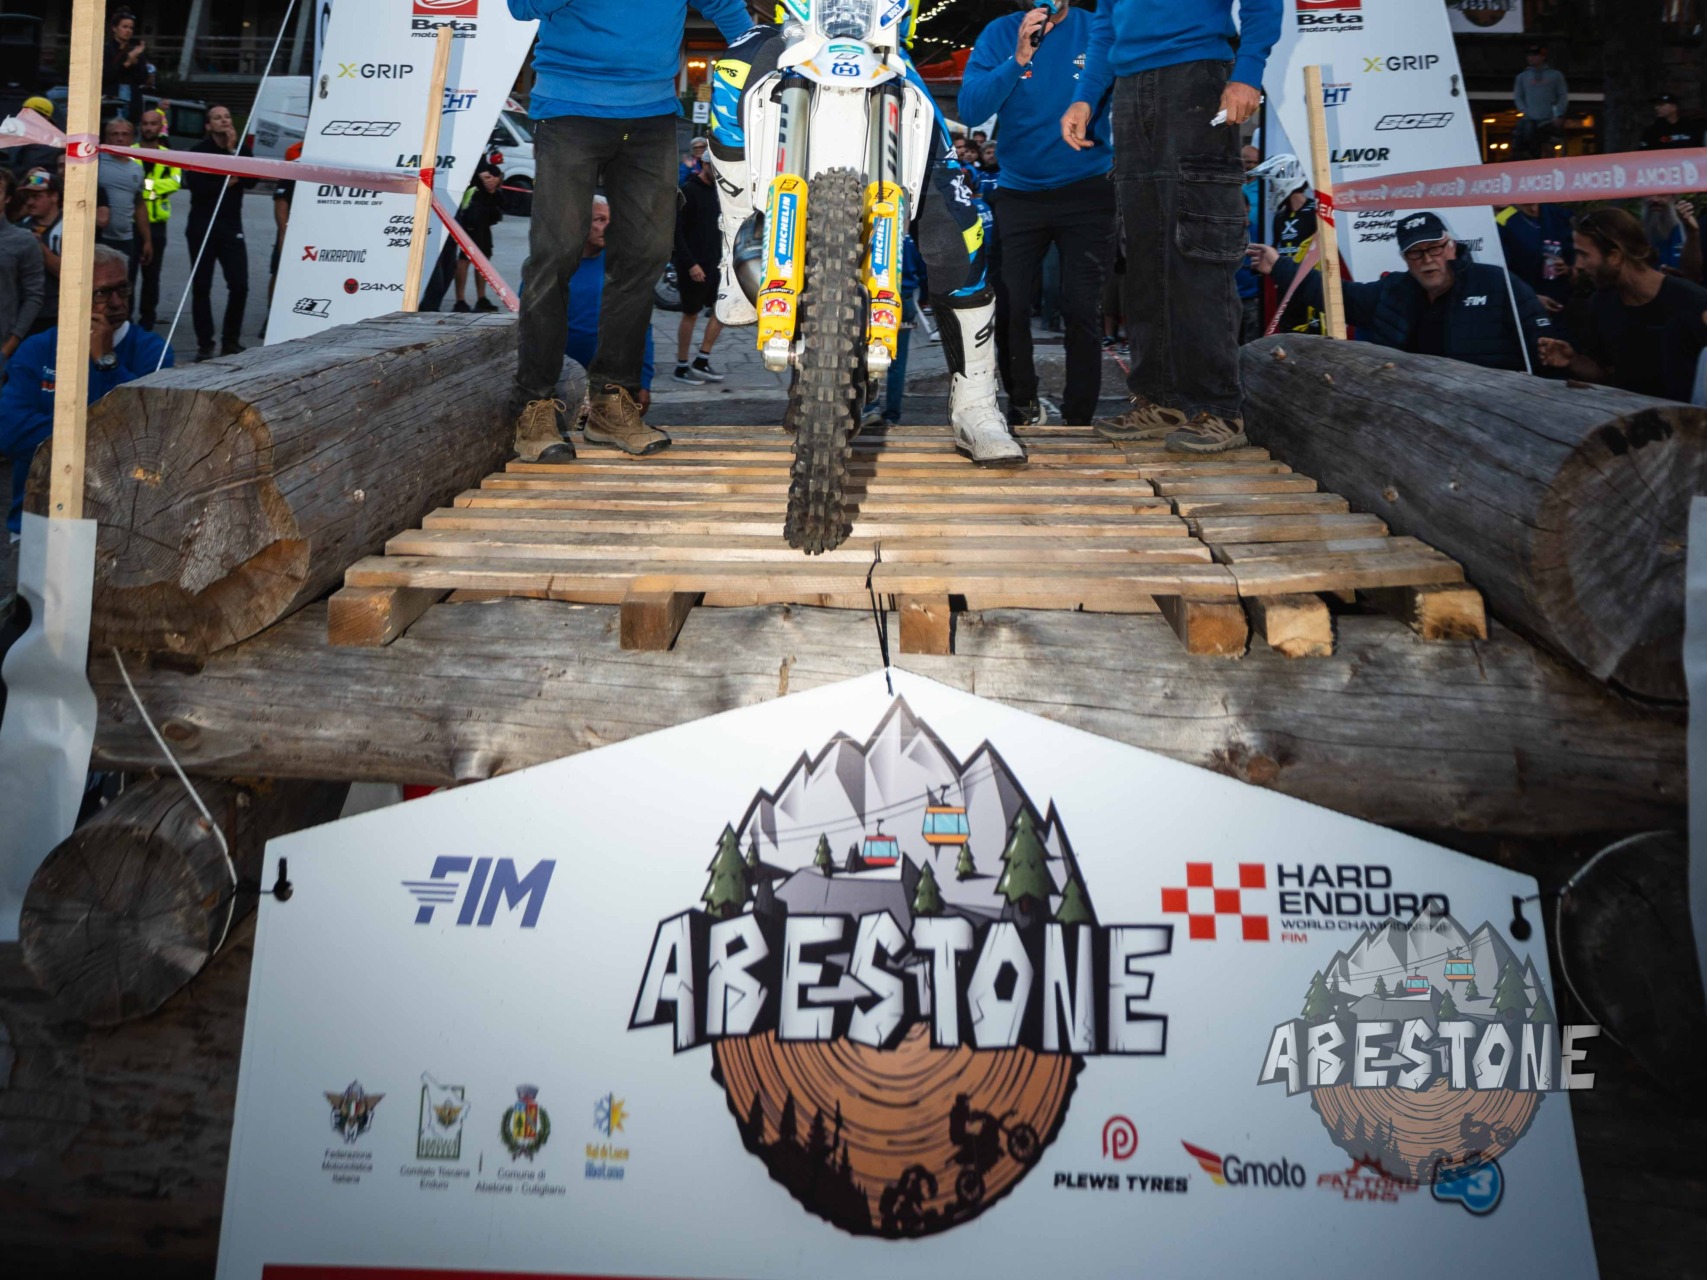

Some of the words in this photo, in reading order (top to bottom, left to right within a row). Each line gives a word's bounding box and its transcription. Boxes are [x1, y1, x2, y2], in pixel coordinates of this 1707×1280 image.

[1297, 12, 1363, 25] Beta
[1298, 25, 1364, 33] motorcycles
[337, 63, 413, 79] X-GRIP
[1363, 54, 1440, 72] X-GRIP
[1331, 147, 1390, 163] LAVOR
[778, 196, 790, 256] MICHELIN
[1403, 217, 1425, 229] FIM
[360, 282, 404, 292] 24MX
[1463, 295, 1487, 307] FIM
[1277, 863, 1392, 889] HARD
[401, 855, 557, 929] FIM
[1279, 891, 1450, 918] ENDURO
[1281, 919, 1336, 931] WORLD
[1281, 933, 1307, 944] FIM
[627, 907, 1174, 1055] ABESTONE
[496, 1167, 535, 1180] Comune
[537, 1168, 546, 1180] di
[1222, 1153, 1307, 1190] Gmoto
[420, 1179, 449, 1190] Enduro
[1053, 1172, 1121, 1192] PLEWS
[1126, 1173, 1189, 1194] TYRES
